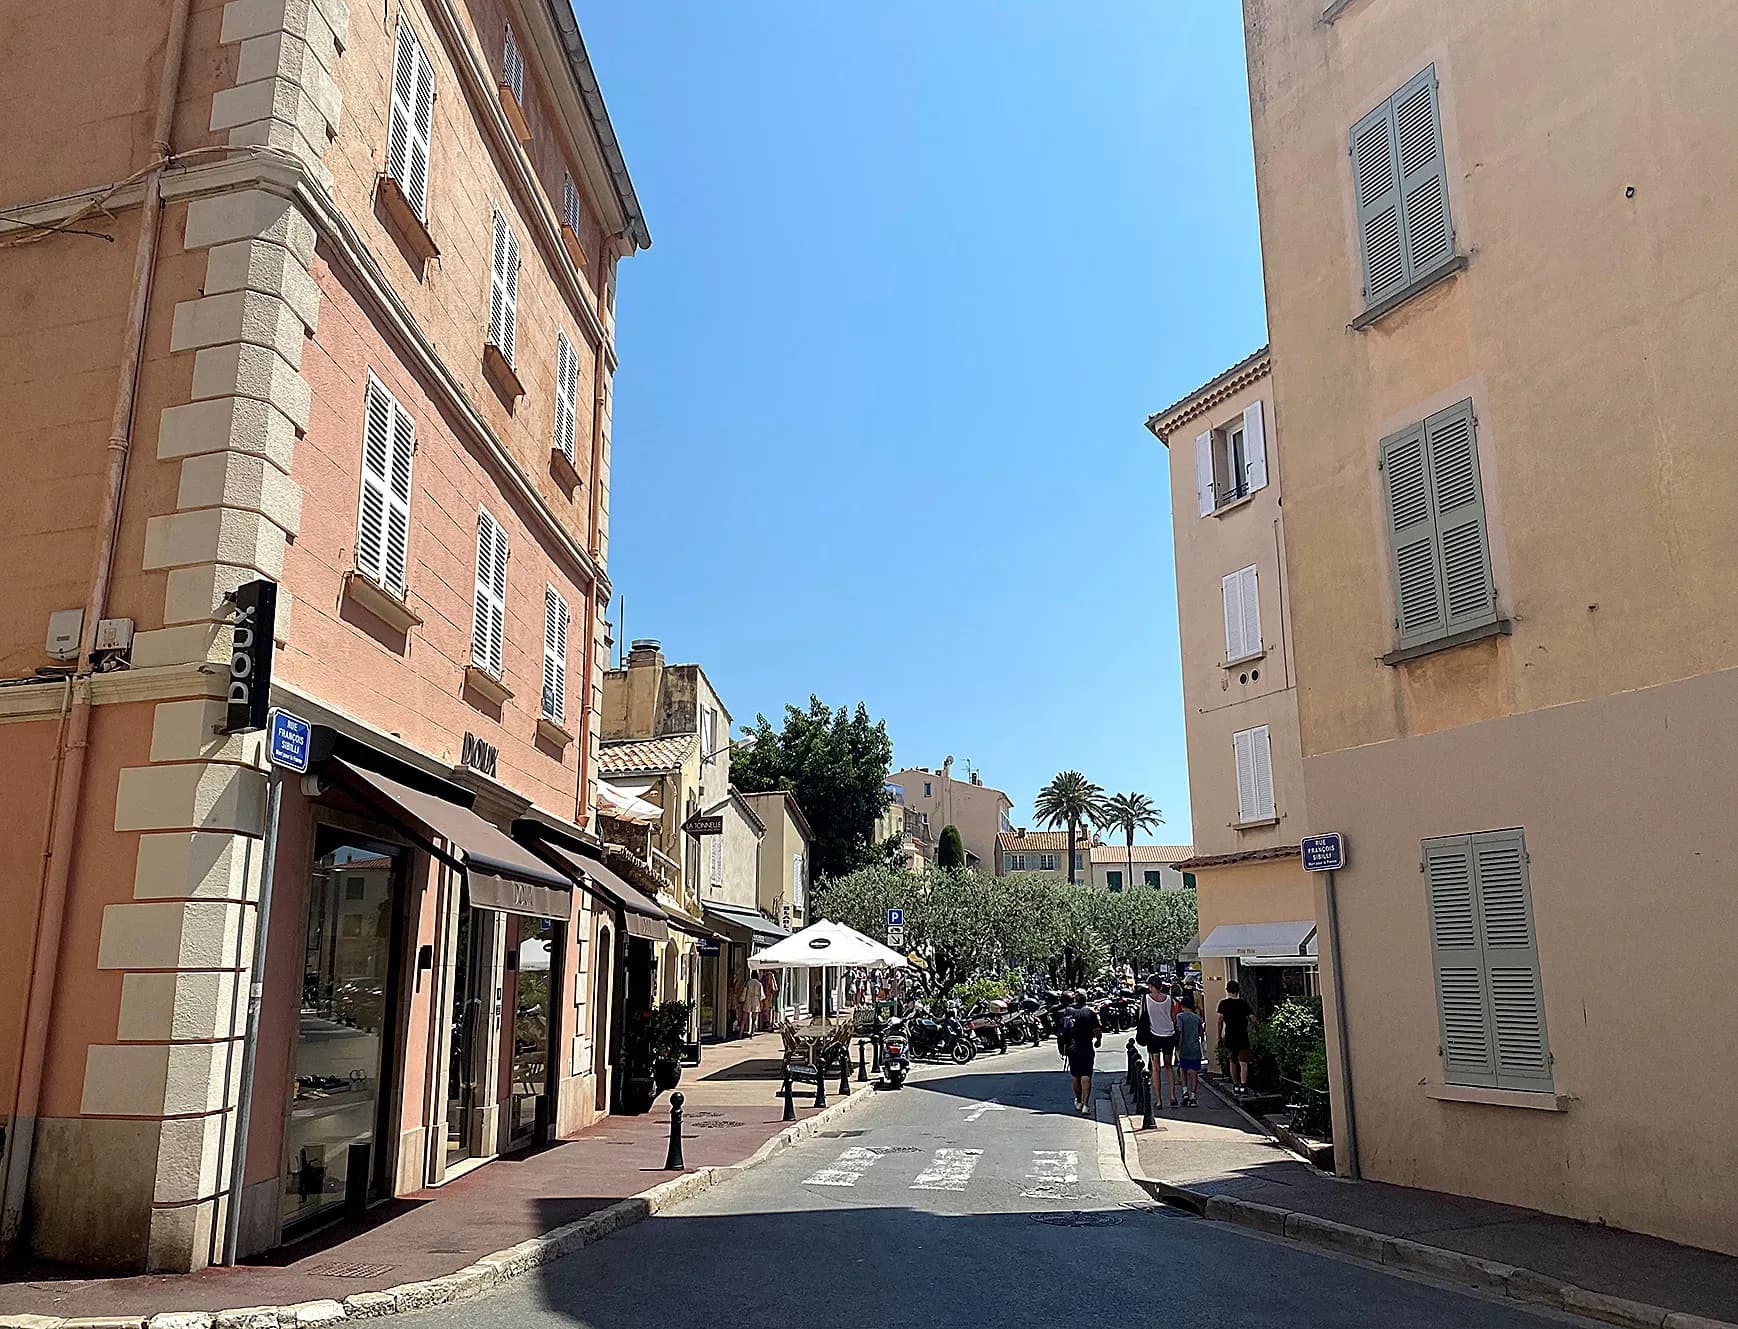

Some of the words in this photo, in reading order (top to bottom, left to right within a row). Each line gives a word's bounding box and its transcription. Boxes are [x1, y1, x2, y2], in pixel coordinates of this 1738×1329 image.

[228, 606, 255, 704] DOUX
[287, 719, 299, 731] RUE
[278, 728, 304, 746] FRANÇOIS
[460, 731, 499, 779] DOUX
[1308, 845, 1335, 853] FRANÇOIS
[891, 911, 899, 923] P
